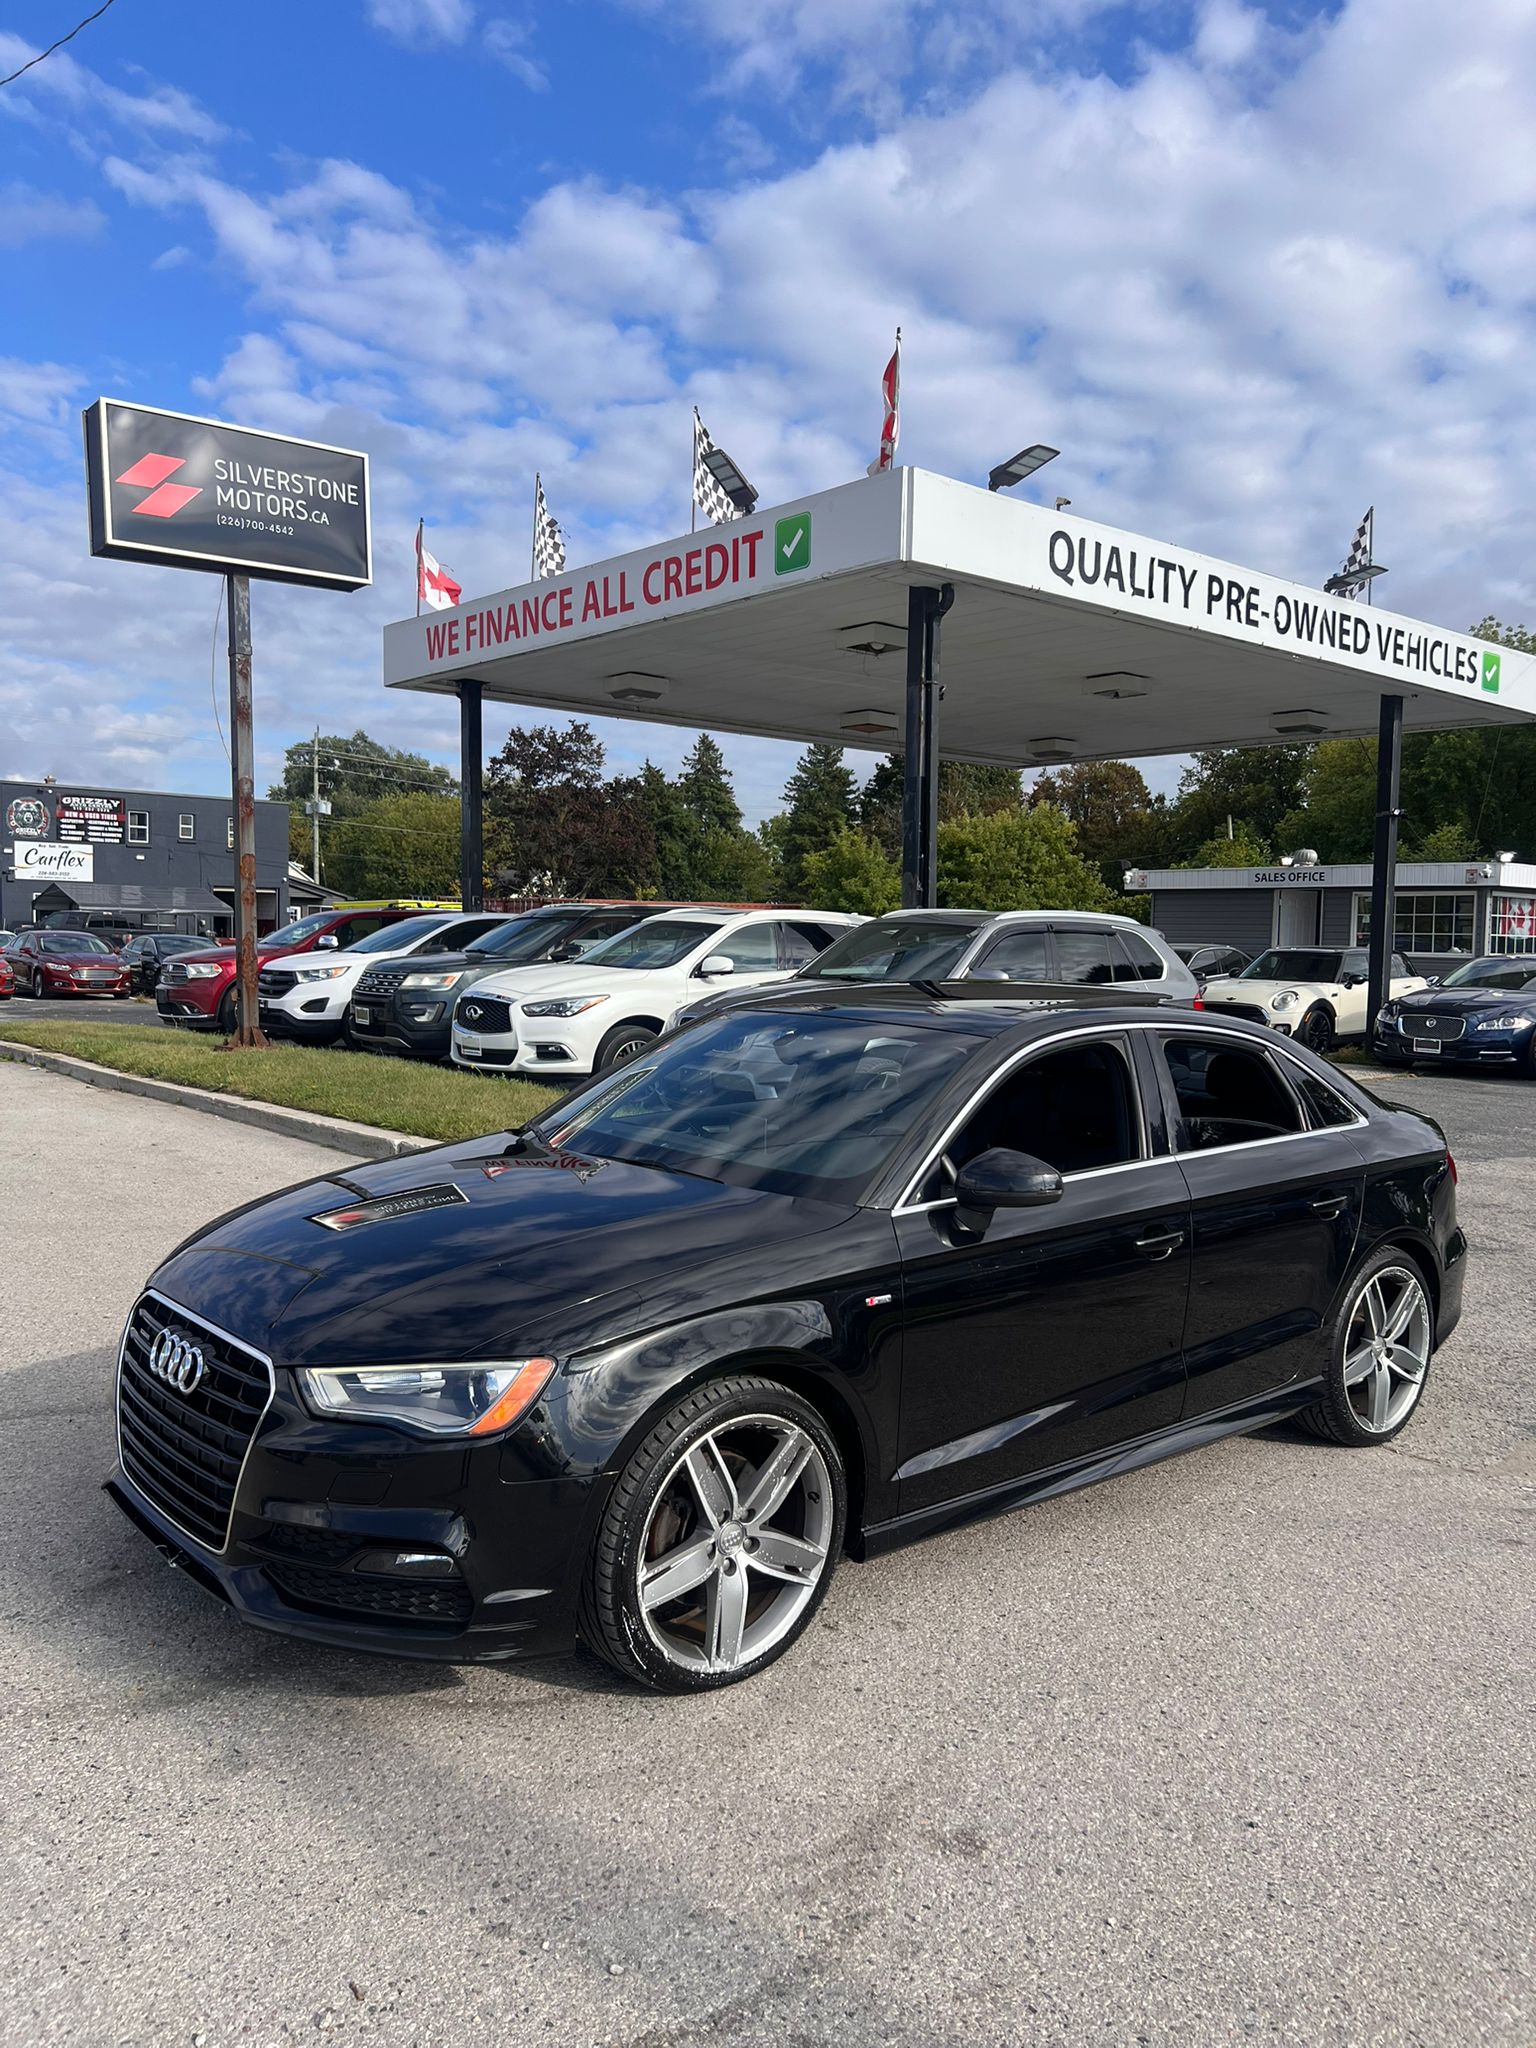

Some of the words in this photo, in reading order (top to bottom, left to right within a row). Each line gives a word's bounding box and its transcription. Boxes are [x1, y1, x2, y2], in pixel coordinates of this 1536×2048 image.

[214, 459, 359, 506] SILVERSTONE
[216, 485, 330, 526] MOTORS.CA
[216, 513, 294, 536] (226)700-4542
[426, 619, 459, 661] WE
[465, 586, 574, 652] FINANCE
[581, 571, 635, 623] ALL
[642, 530, 764, 606] CREDIT
[1048, 529, 1198, 609] QUALITY
[1206, 574, 1371, 655] PRE-OWNED
[1376, 623, 1479, 685] VEHICLES
[62, 796, 120, 808] GRIZZLY
[24, 848, 85, 870] Carflex
[1254, 872, 1286, 883] SALES
[1288, 872, 1326, 882] OFFICE
